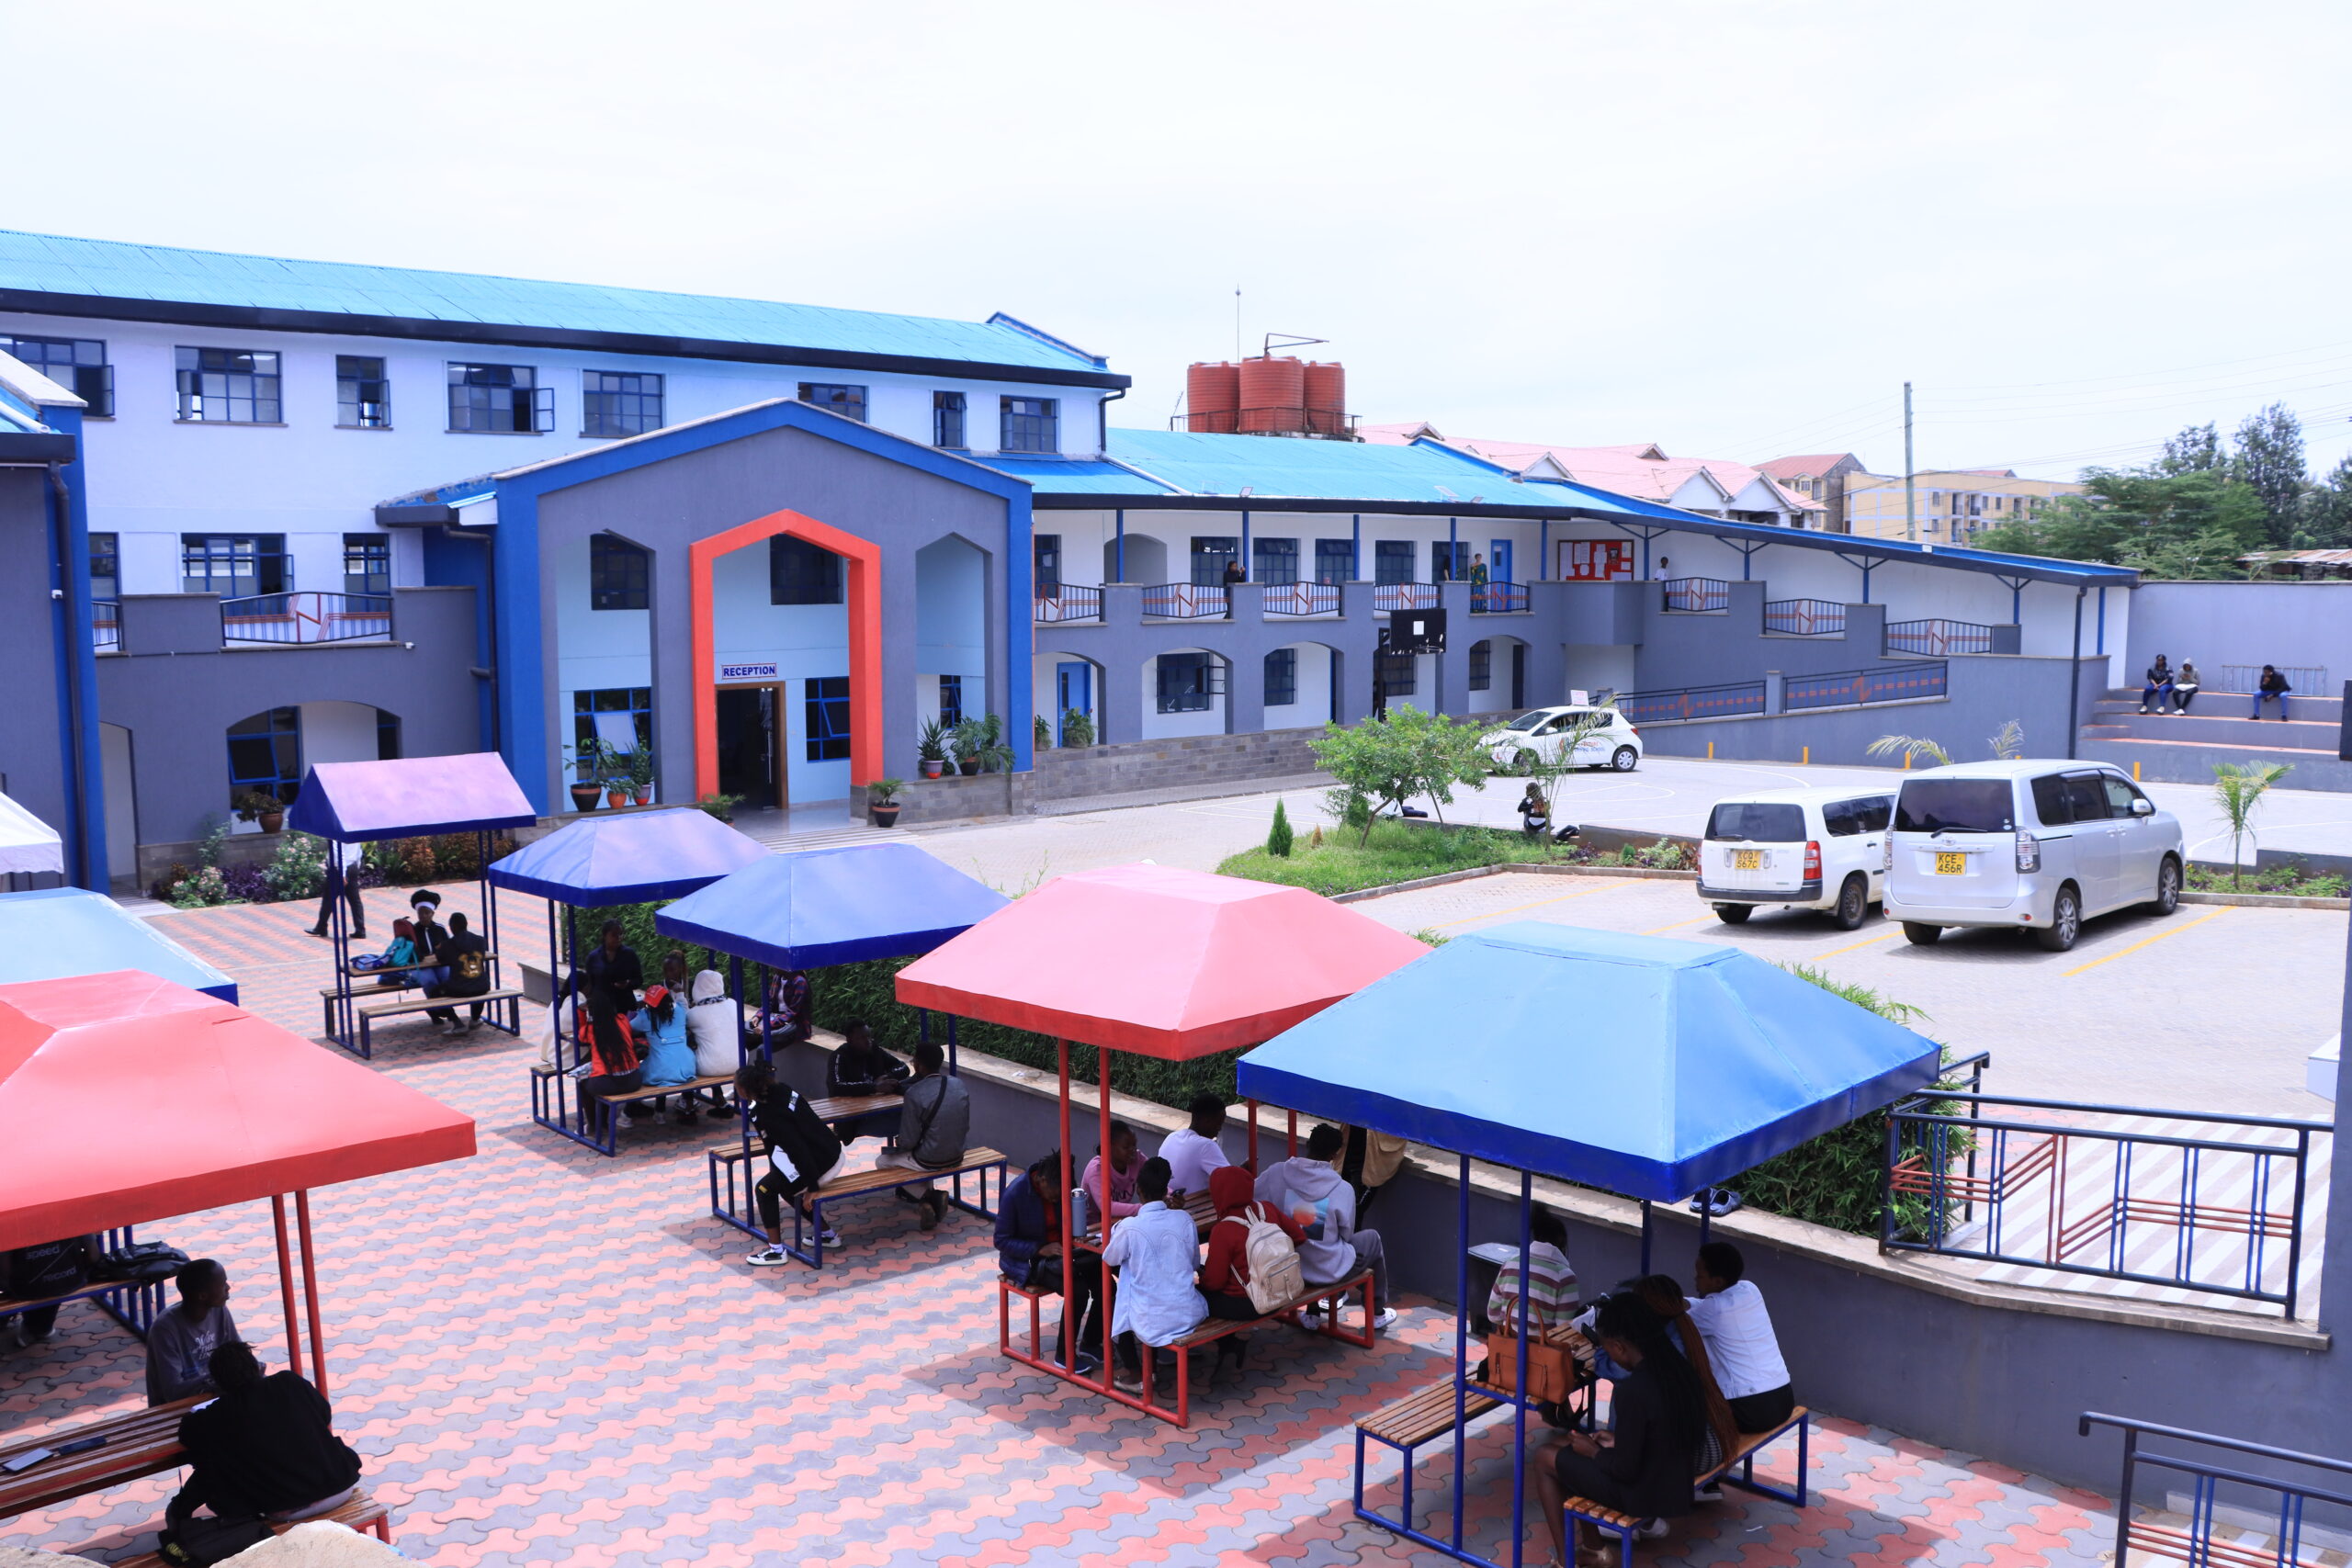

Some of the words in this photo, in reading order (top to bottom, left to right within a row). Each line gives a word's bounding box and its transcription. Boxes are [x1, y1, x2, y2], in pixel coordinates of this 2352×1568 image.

[723, 666, 775, 676] RECEPTION
[1737, 852, 1754, 860] KCQ
[1938, 854, 1958, 863] KCE
[1736, 860, 1758, 868] 567C
[1938, 863, 1962, 874] 456R
[27, 1245, 60, 1259] speed
[43, 1265, 77, 1281] record
